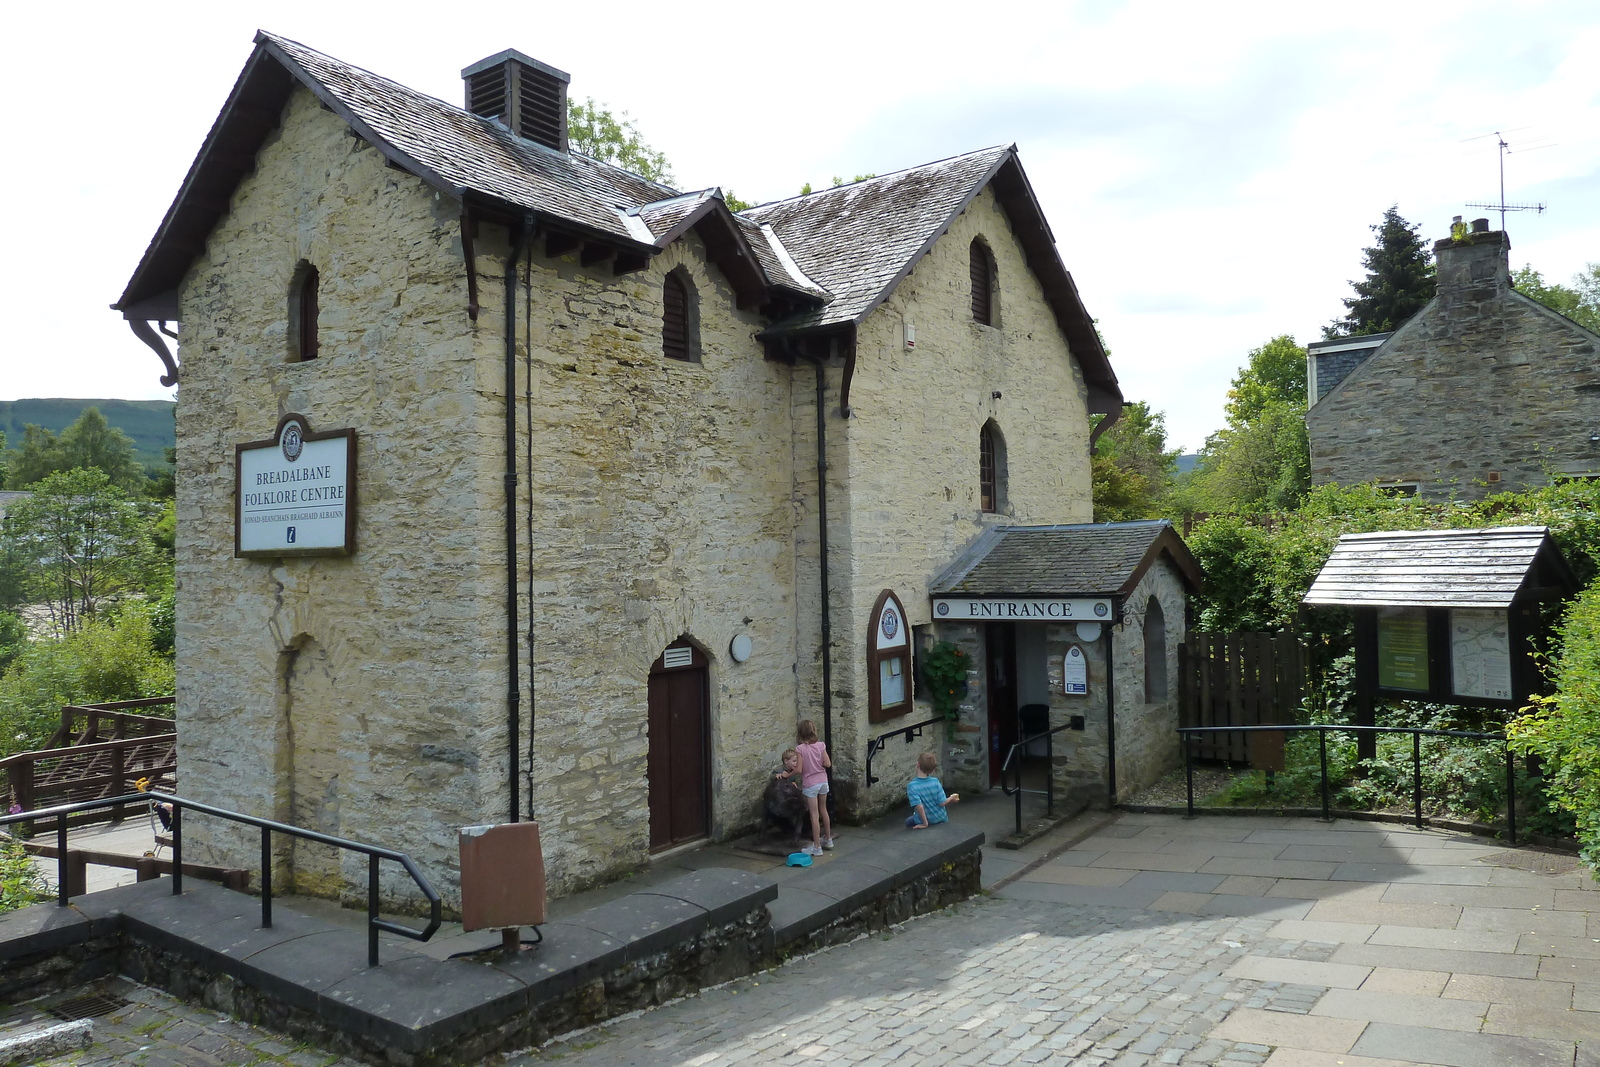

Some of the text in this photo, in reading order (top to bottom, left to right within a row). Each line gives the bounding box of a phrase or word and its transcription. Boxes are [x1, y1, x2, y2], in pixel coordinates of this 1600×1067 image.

[257, 466, 331, 485] BREADALBANE
[245, 486, 344, 506] FOLKLORE CENTRE
[968, 602, 1073, 617] ENTRANCE
